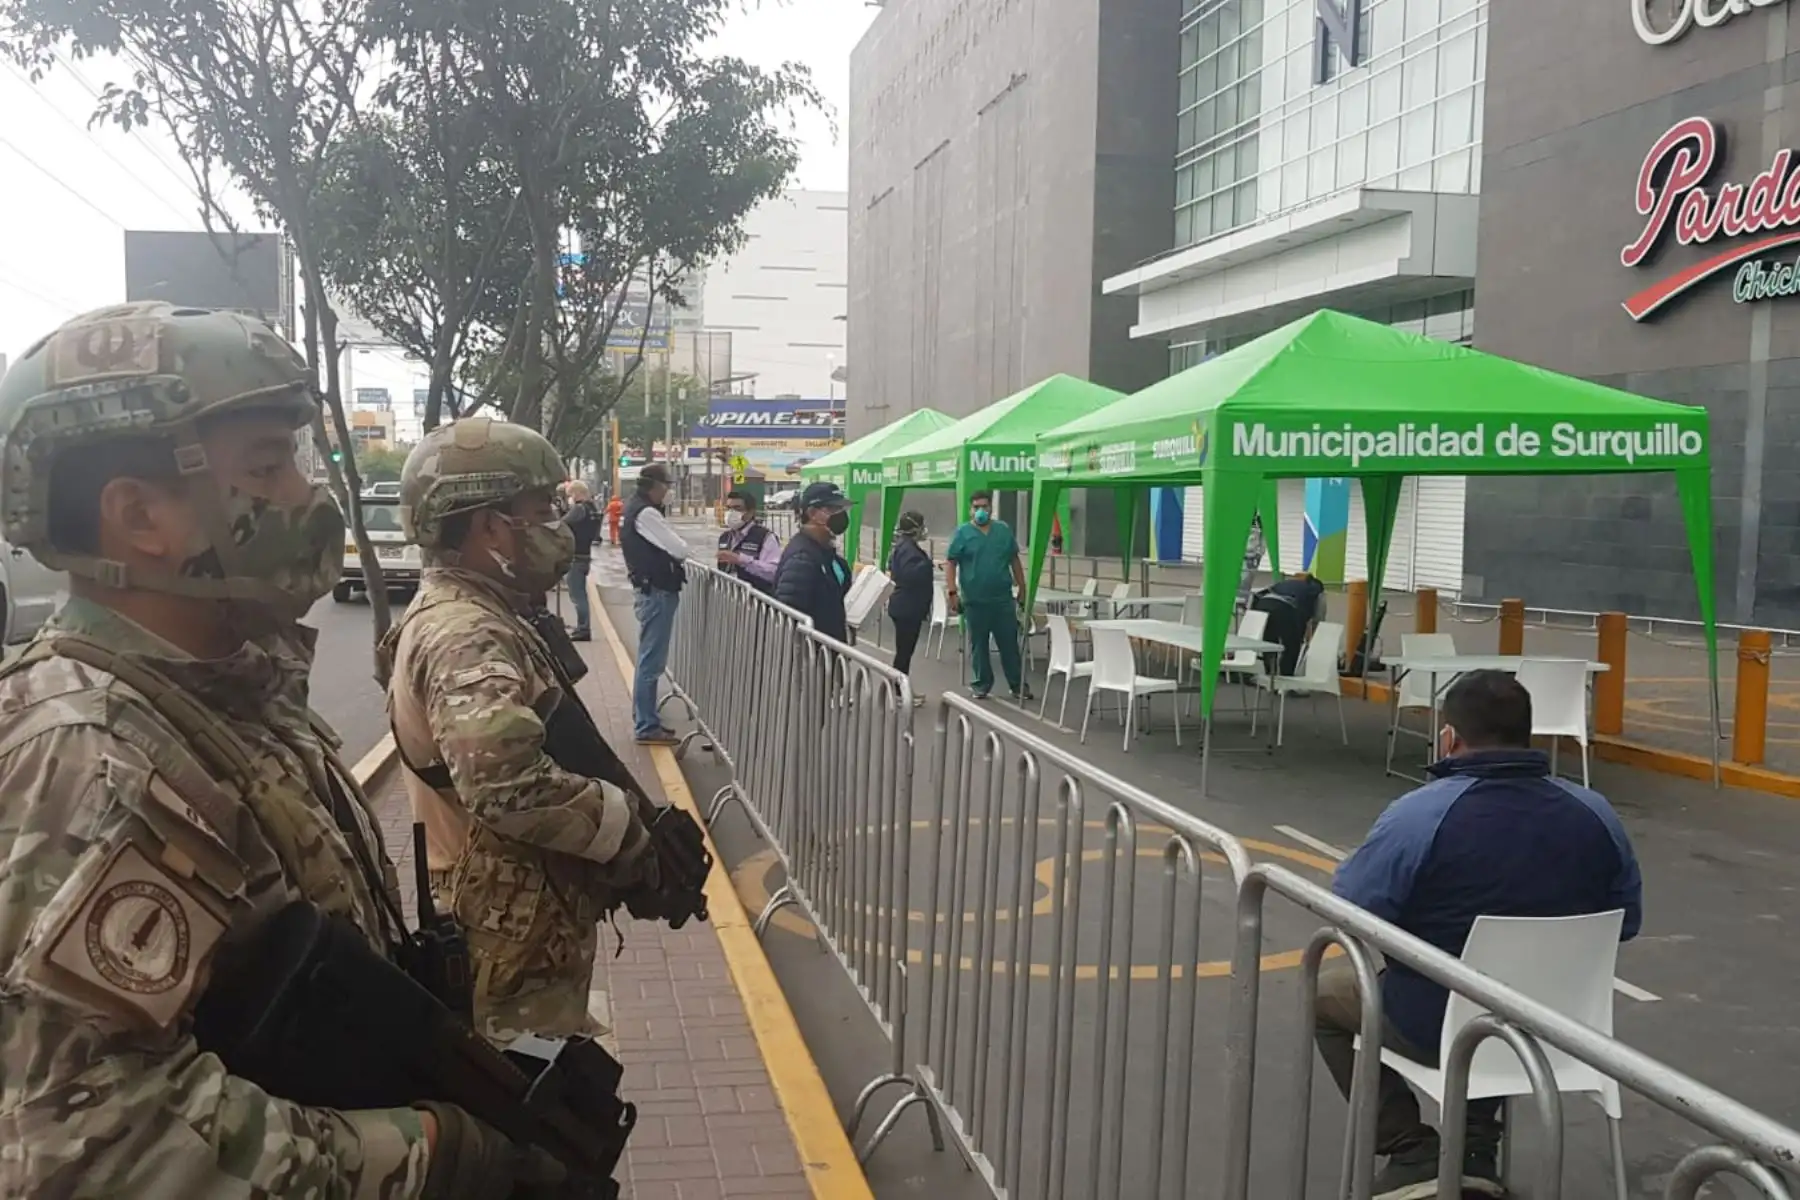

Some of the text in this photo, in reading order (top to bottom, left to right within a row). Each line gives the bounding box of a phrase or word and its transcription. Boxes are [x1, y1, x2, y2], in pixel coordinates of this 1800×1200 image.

[1232, 422, 1702, 467] Municipalidad de Surquillo
